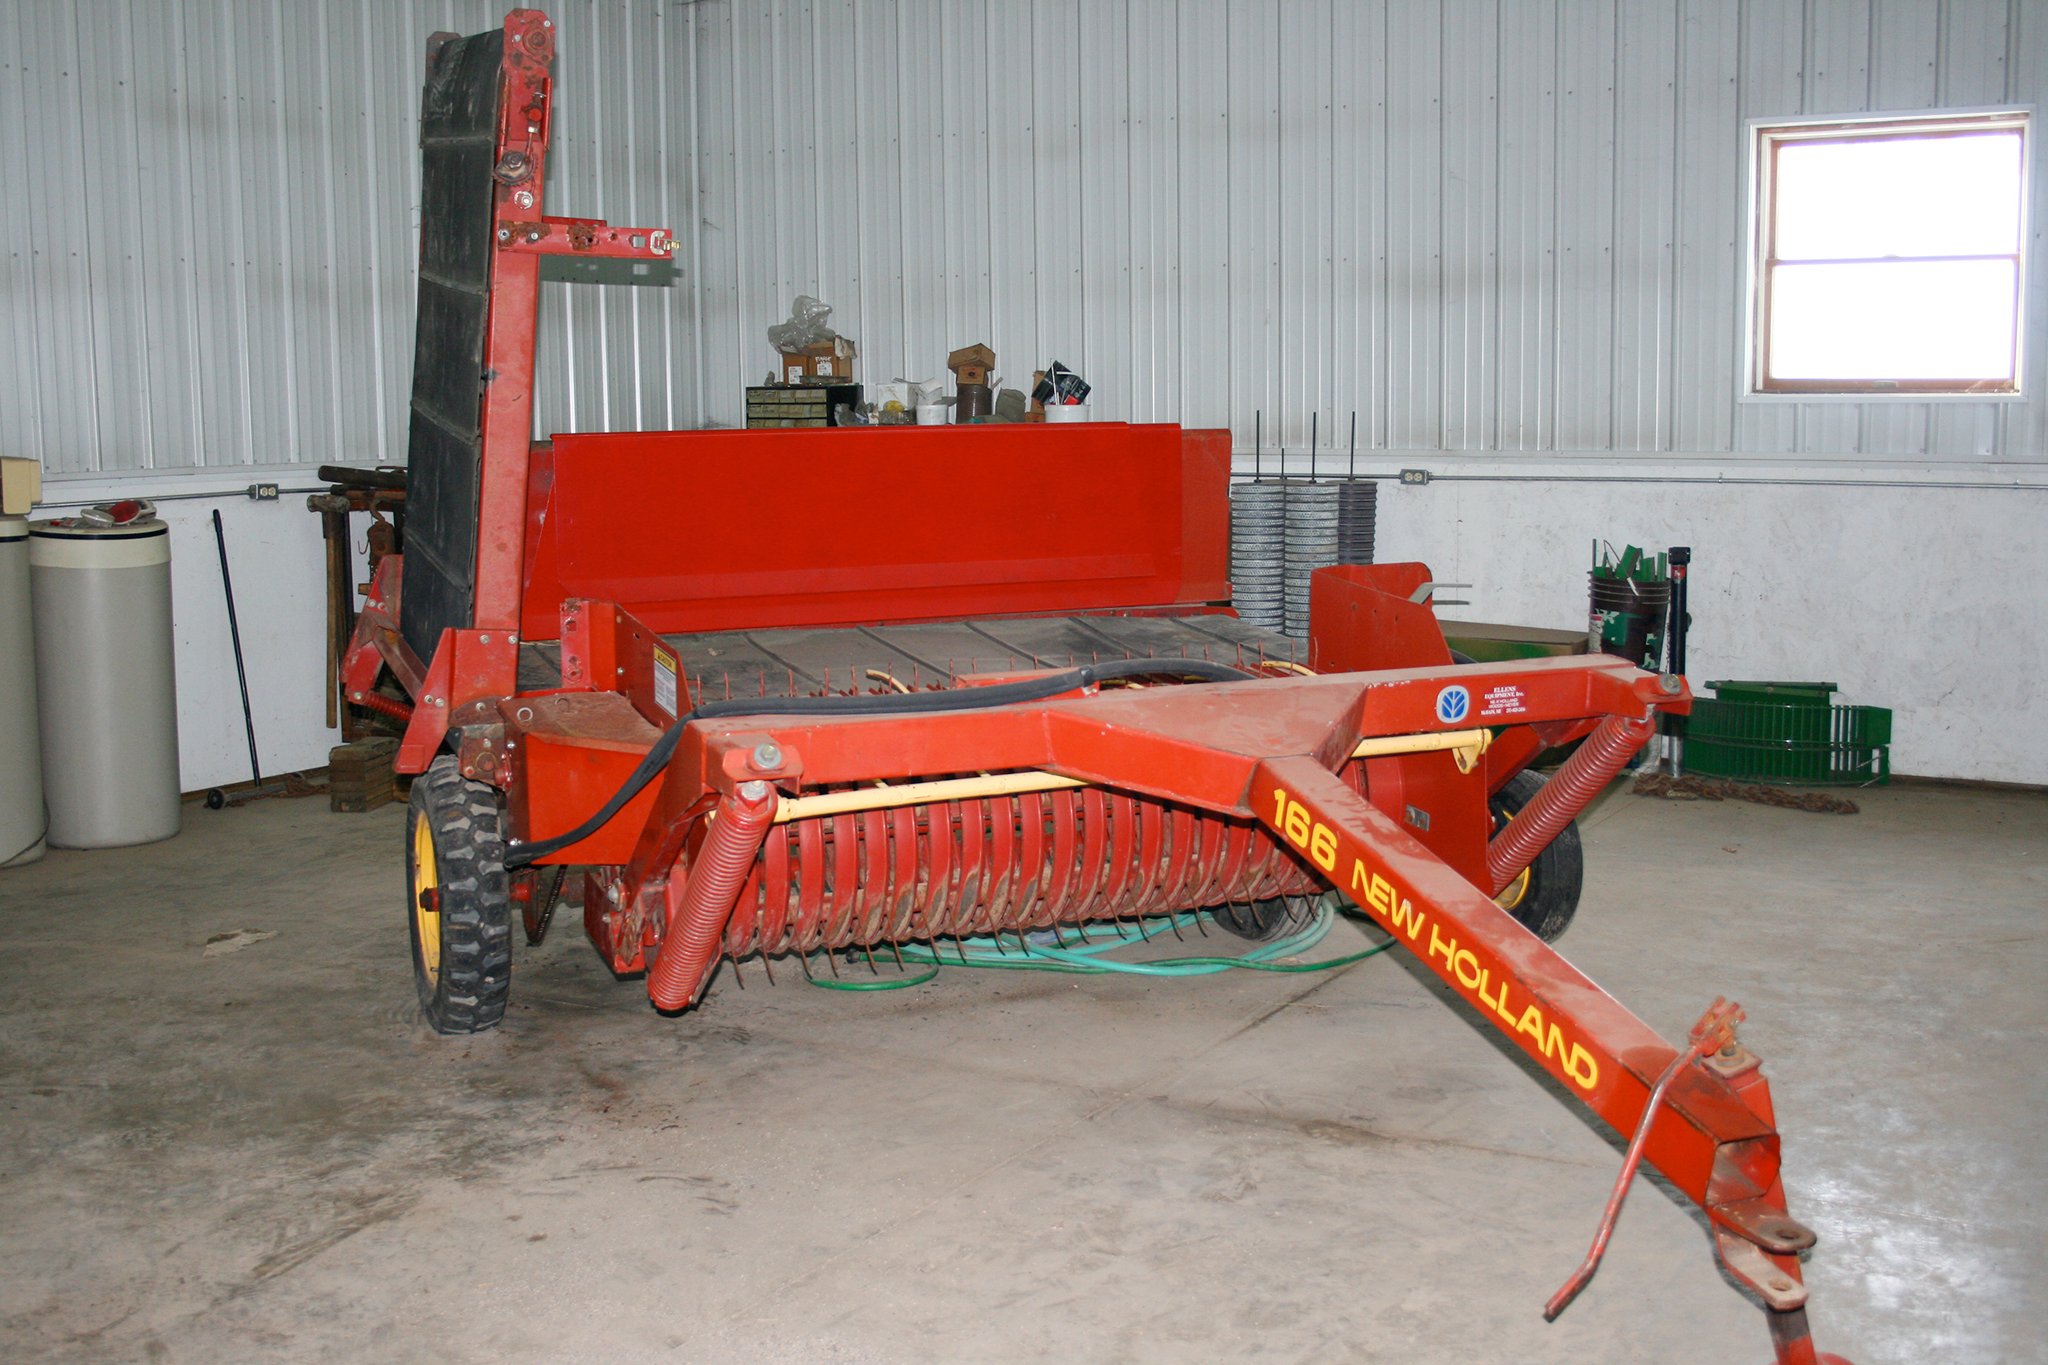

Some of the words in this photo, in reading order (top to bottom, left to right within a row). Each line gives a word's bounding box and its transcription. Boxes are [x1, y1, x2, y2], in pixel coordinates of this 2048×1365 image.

[1274, 789, 1337, 871] 166
[1352, 859, 1425, 940] NEW
[1429, 924, 1598, 1089] HOLLAND
